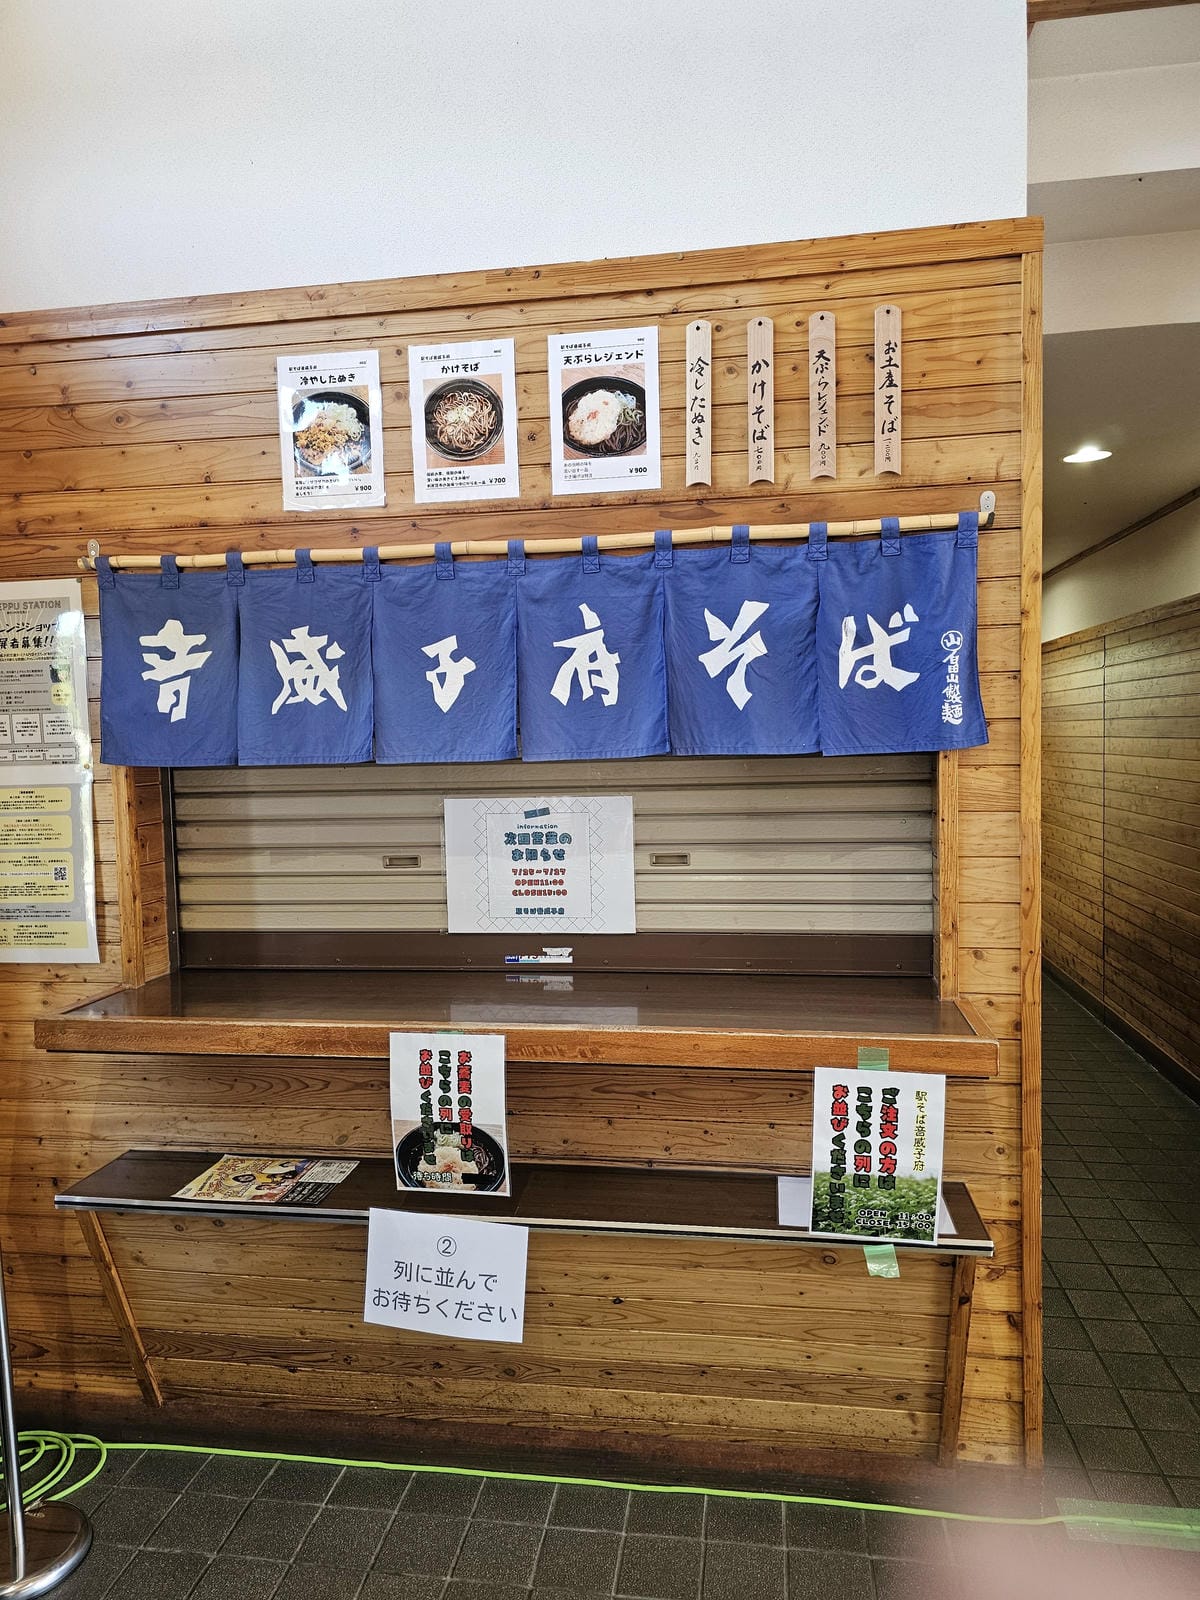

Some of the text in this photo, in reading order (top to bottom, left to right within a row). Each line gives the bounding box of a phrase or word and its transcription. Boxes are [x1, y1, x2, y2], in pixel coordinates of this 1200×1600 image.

[441, 361, 481, 375] かけそば
[563, 349, 644, 366] 天ぷらレジェンド
[299, 373, 356, 386] 冷やしたぬき
[812, 349, 831, 437] 天ぷらレジェンド
[878, 339, 900, 435] お土産そば
[690, 356, 710, 446] 冷したぬき
[751, 359, 770, 444] かけそば
[23, 600, 62, 610] STATION
[504, 831, 573, 846] 次回営業の
[511, 848, 566, 861] お知らせ
[438, 1049, 454, 1135] こちらの列に
[853, 1086, 873, 1189] こちらの列に
[878, 1087, 900, 1191] ご注文の方は
[912, 1090, 928, 1172] 駅そば音威子府
[855, 1218, 890, 1227] CLOSE
[858, 1209, 887, 1218] OPEN
[393, 1260, 498, 1292] 列に並んで
[372, 1287, 518, 1323] お待ちください
